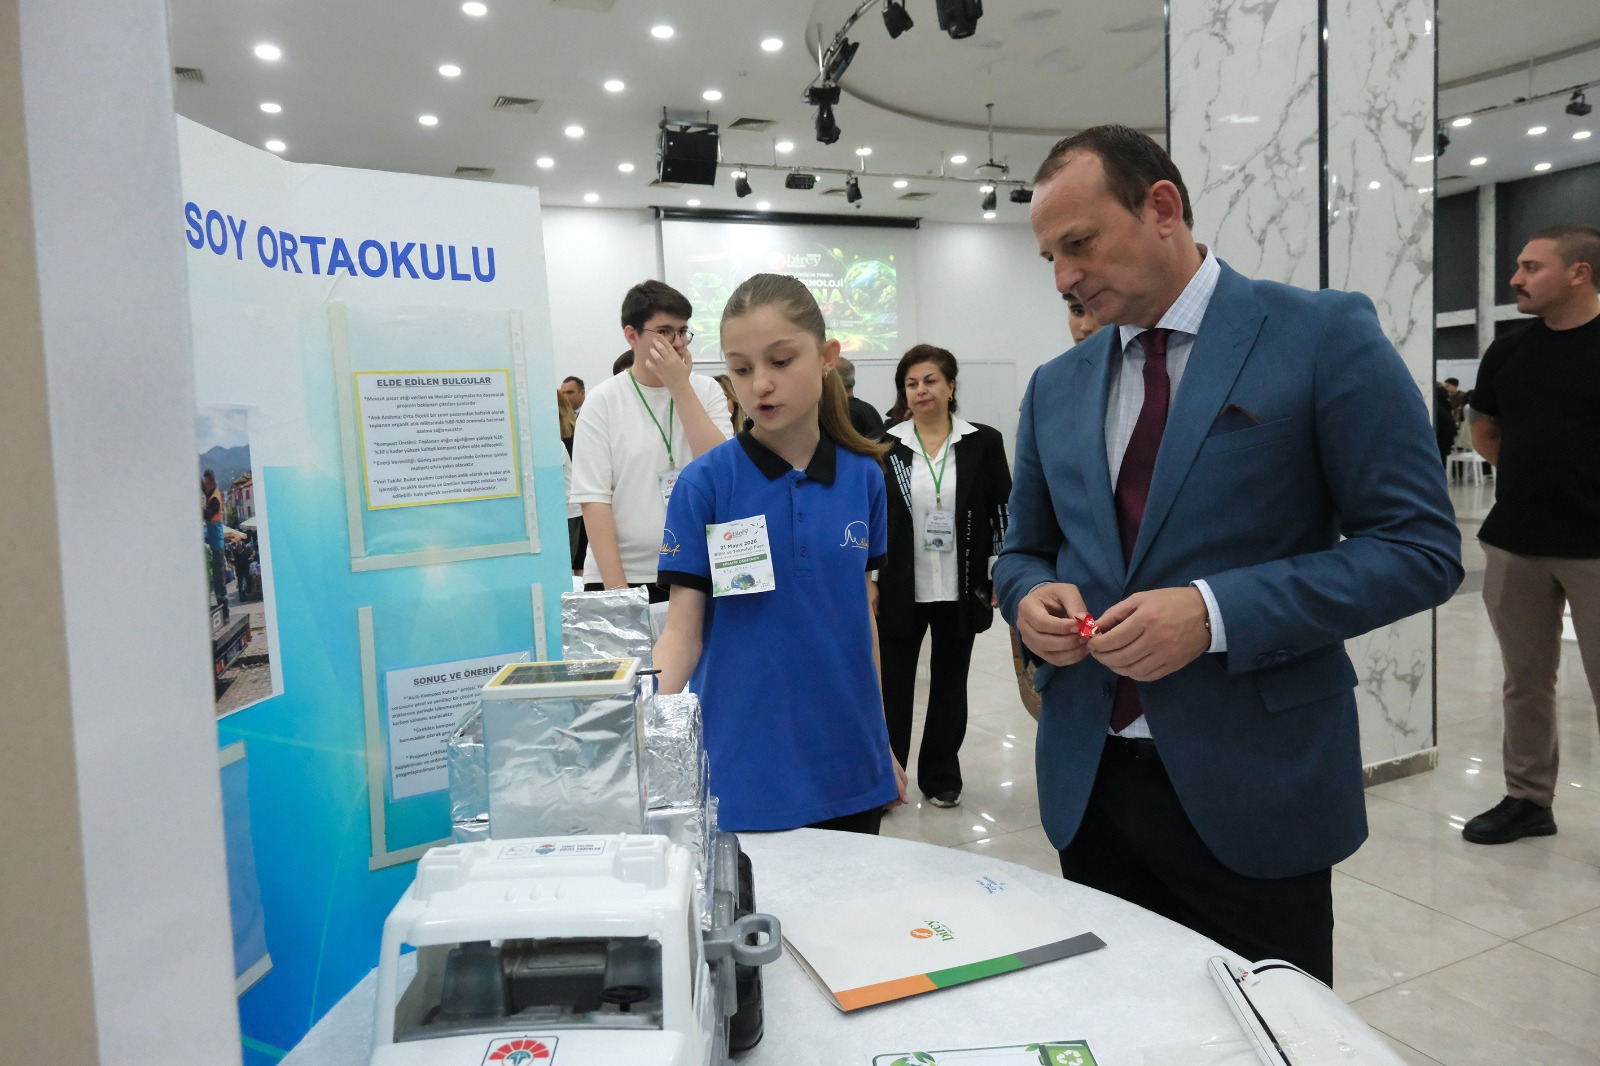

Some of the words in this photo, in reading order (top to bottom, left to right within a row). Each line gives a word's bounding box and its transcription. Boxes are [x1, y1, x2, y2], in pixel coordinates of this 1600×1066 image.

[185, 202, 247, 260] SOY
[257, 225, 496, 283] ORTAOKULU
[804, 278, 844, 288] KNOLOJİ
[813, 288, 844, 304] NA
[377, 379, 402, 387] ELDE
[405, 377, 439, 386] EDİLEN
[442, 377, 491, 385] BULGULAR
[413, 674, 447, 686] SONUÇ
[449, 671, 462, 680] VE
[464, 665, 505, 677] ÖNERİLE
